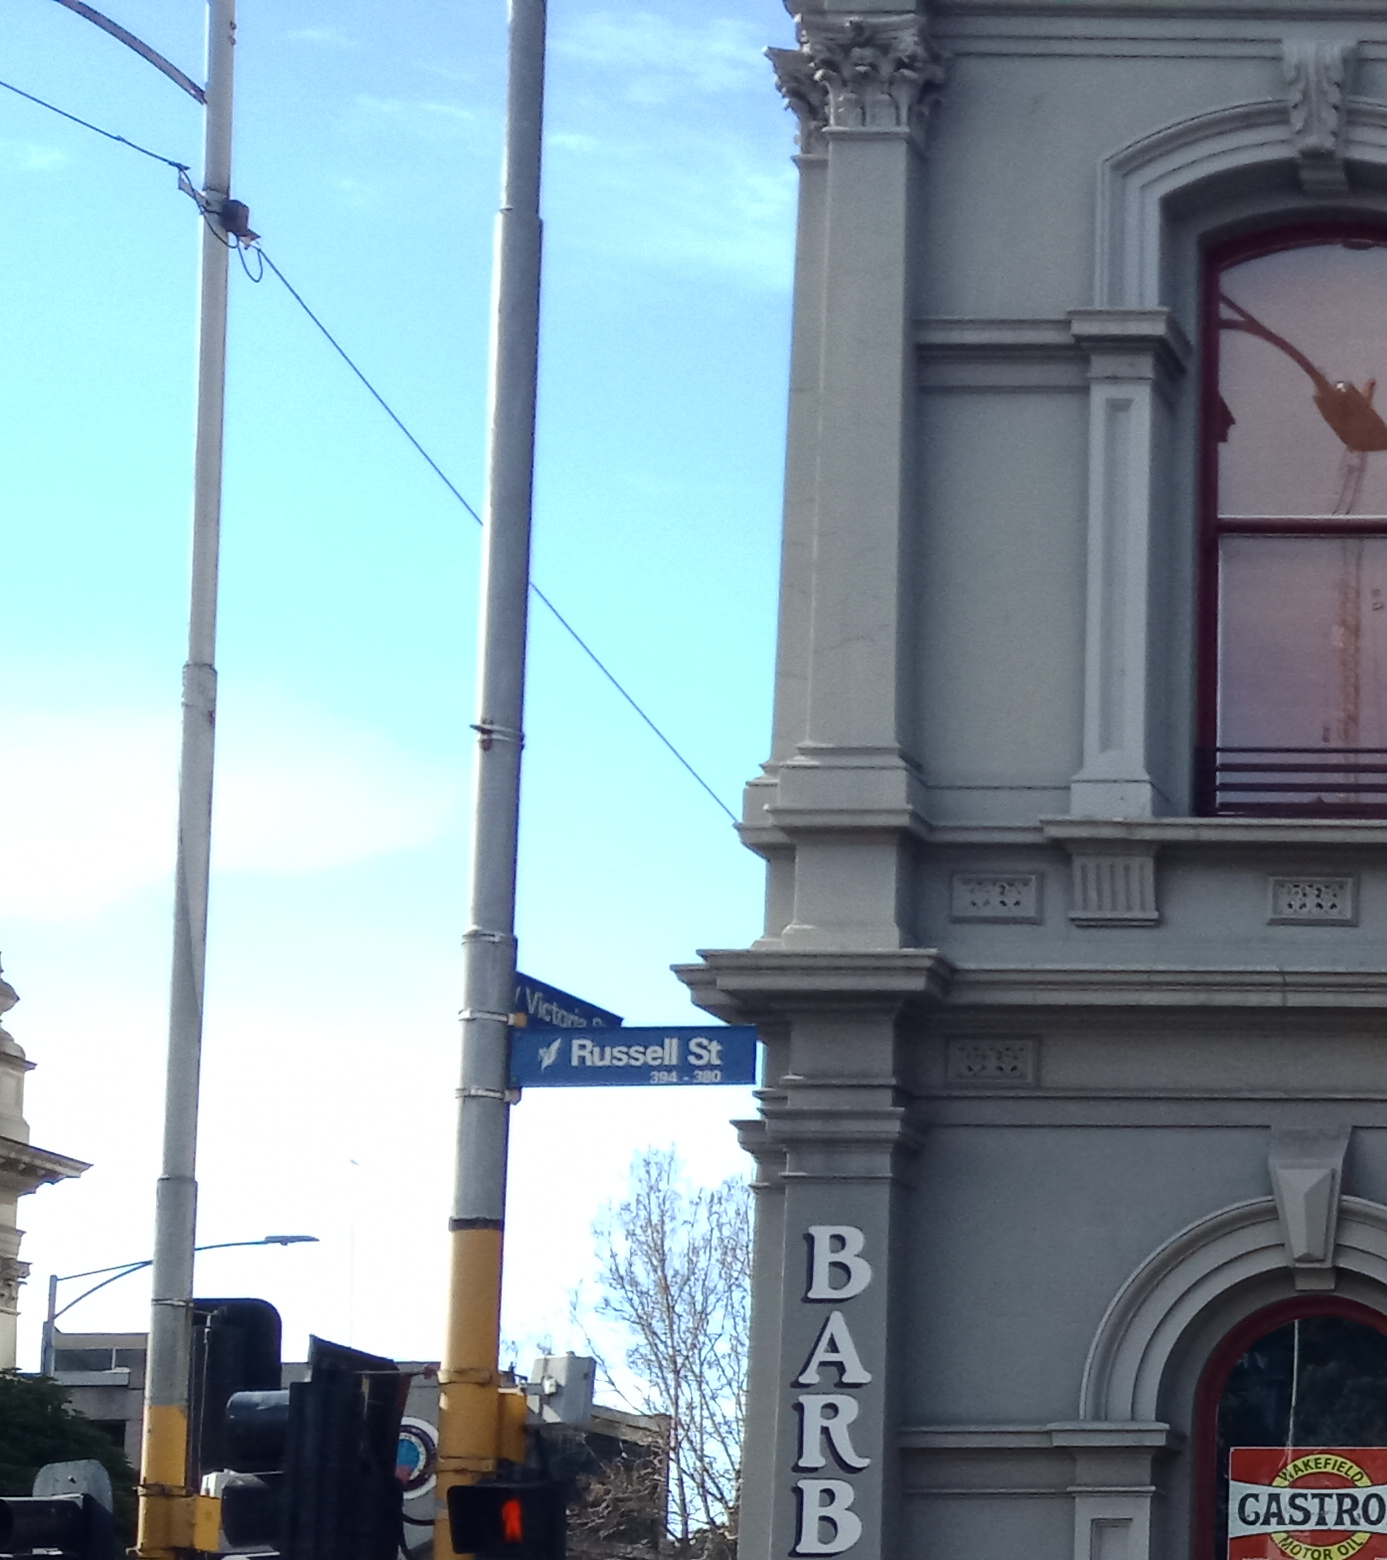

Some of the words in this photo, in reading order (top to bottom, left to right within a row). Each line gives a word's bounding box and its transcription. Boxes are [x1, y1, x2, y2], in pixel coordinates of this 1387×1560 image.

[571, 1038, 679, 1066] Russell
[688, 1037, 722, 1066] St
[650, 1071, 678, 1083] 394
[695, 1070, 721, 1083] 380
[1278, 1457, 1364, 1483] WAKEFIELD
[1278, 1535, 1333, 1560] MOTOR
[1337, 1537, 1364, 1556] OIL
